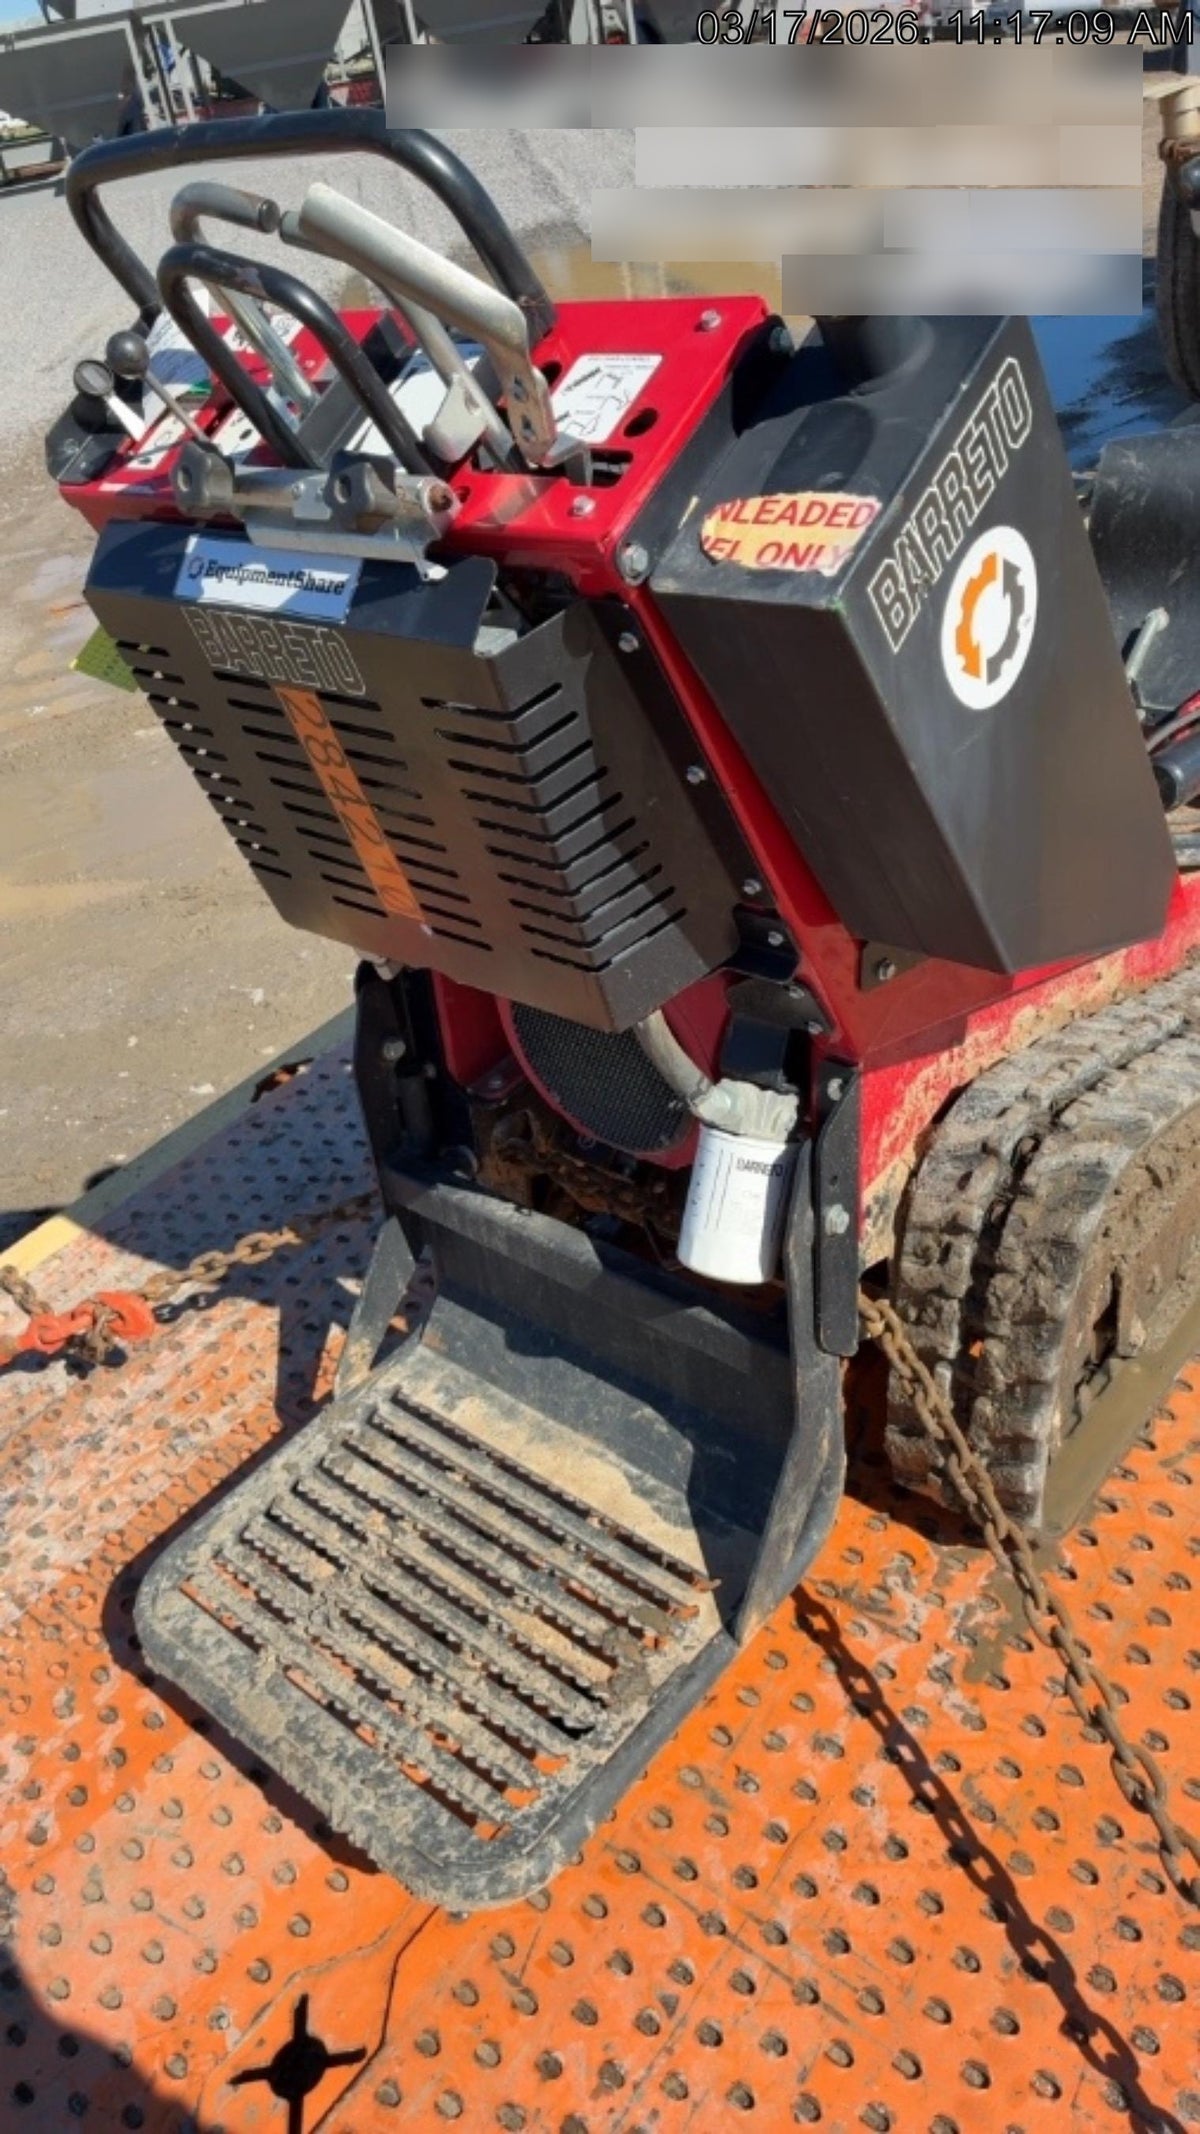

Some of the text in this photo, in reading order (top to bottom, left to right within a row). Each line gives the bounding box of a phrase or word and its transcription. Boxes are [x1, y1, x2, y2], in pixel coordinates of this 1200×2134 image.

[704, 497, 877, 529] NLEADED
[867, 356, 1032, 654] BARRETO
[204, 558, 346, 596] EquipmentShare
[180, 606, 367, 696] BARRETO
